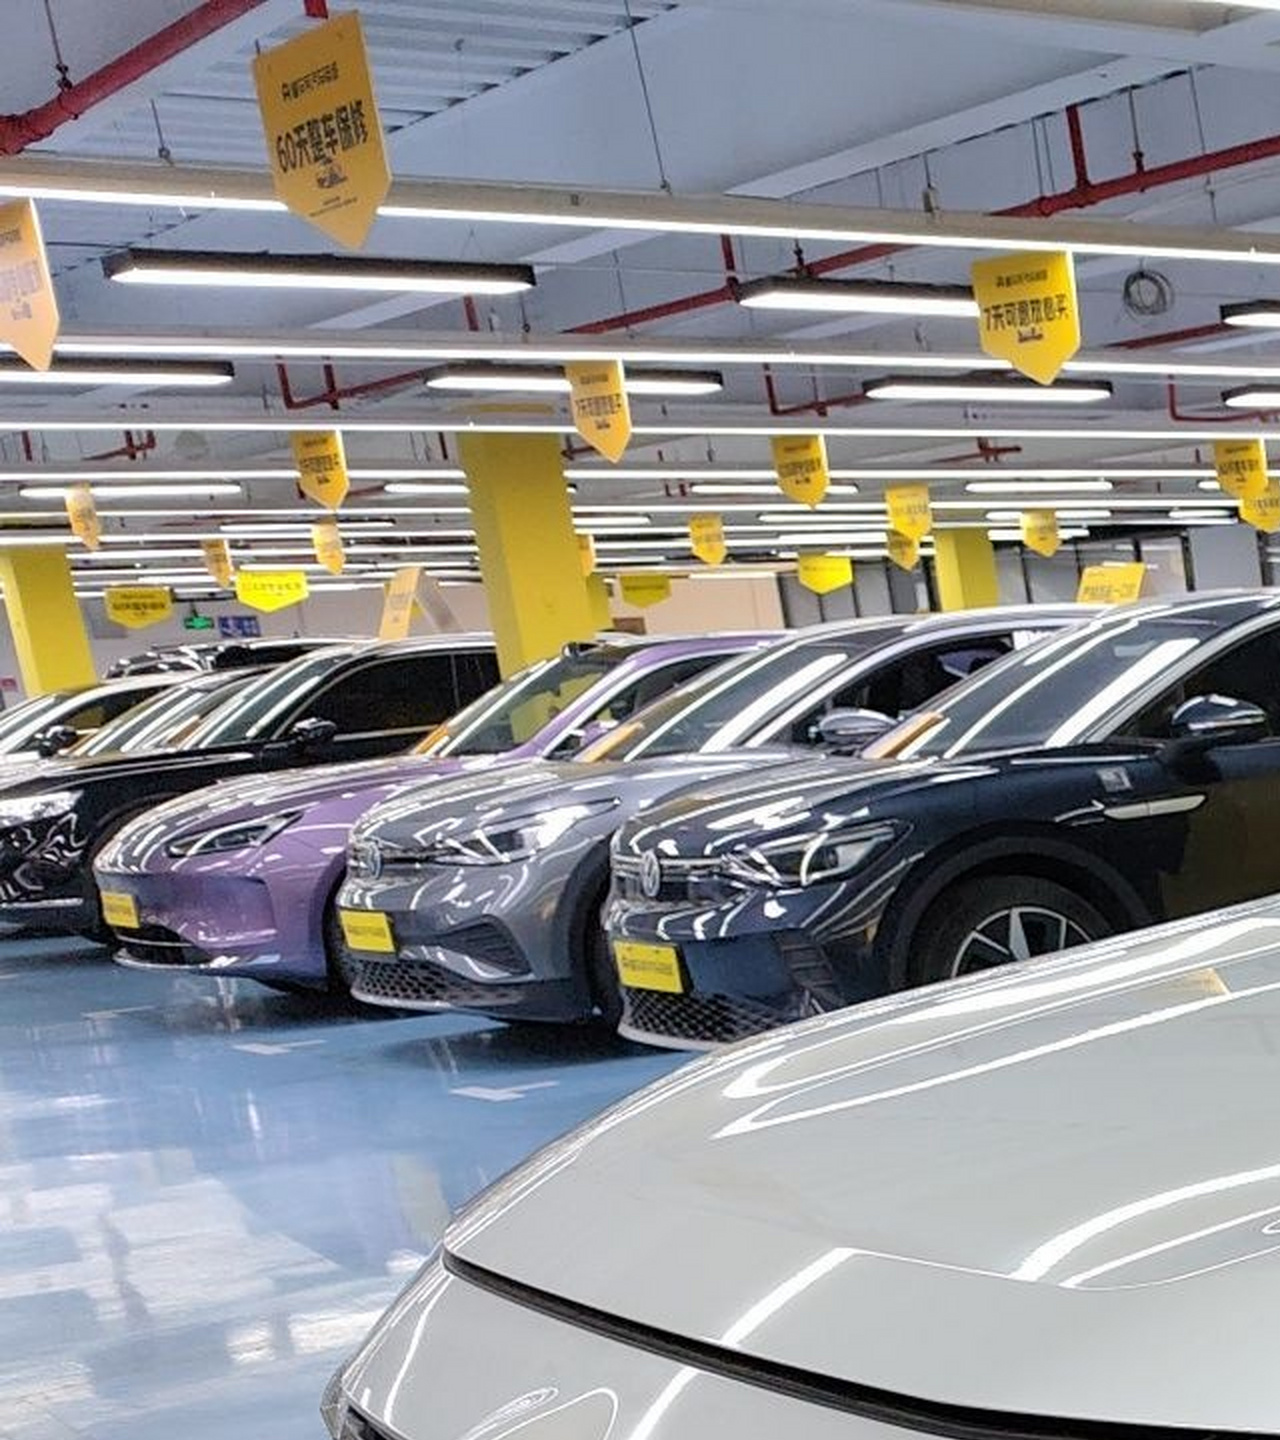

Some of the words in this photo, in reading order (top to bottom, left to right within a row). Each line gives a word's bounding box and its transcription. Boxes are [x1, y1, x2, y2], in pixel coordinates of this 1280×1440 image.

[276, 99, 369, 173] 60天整车保修
